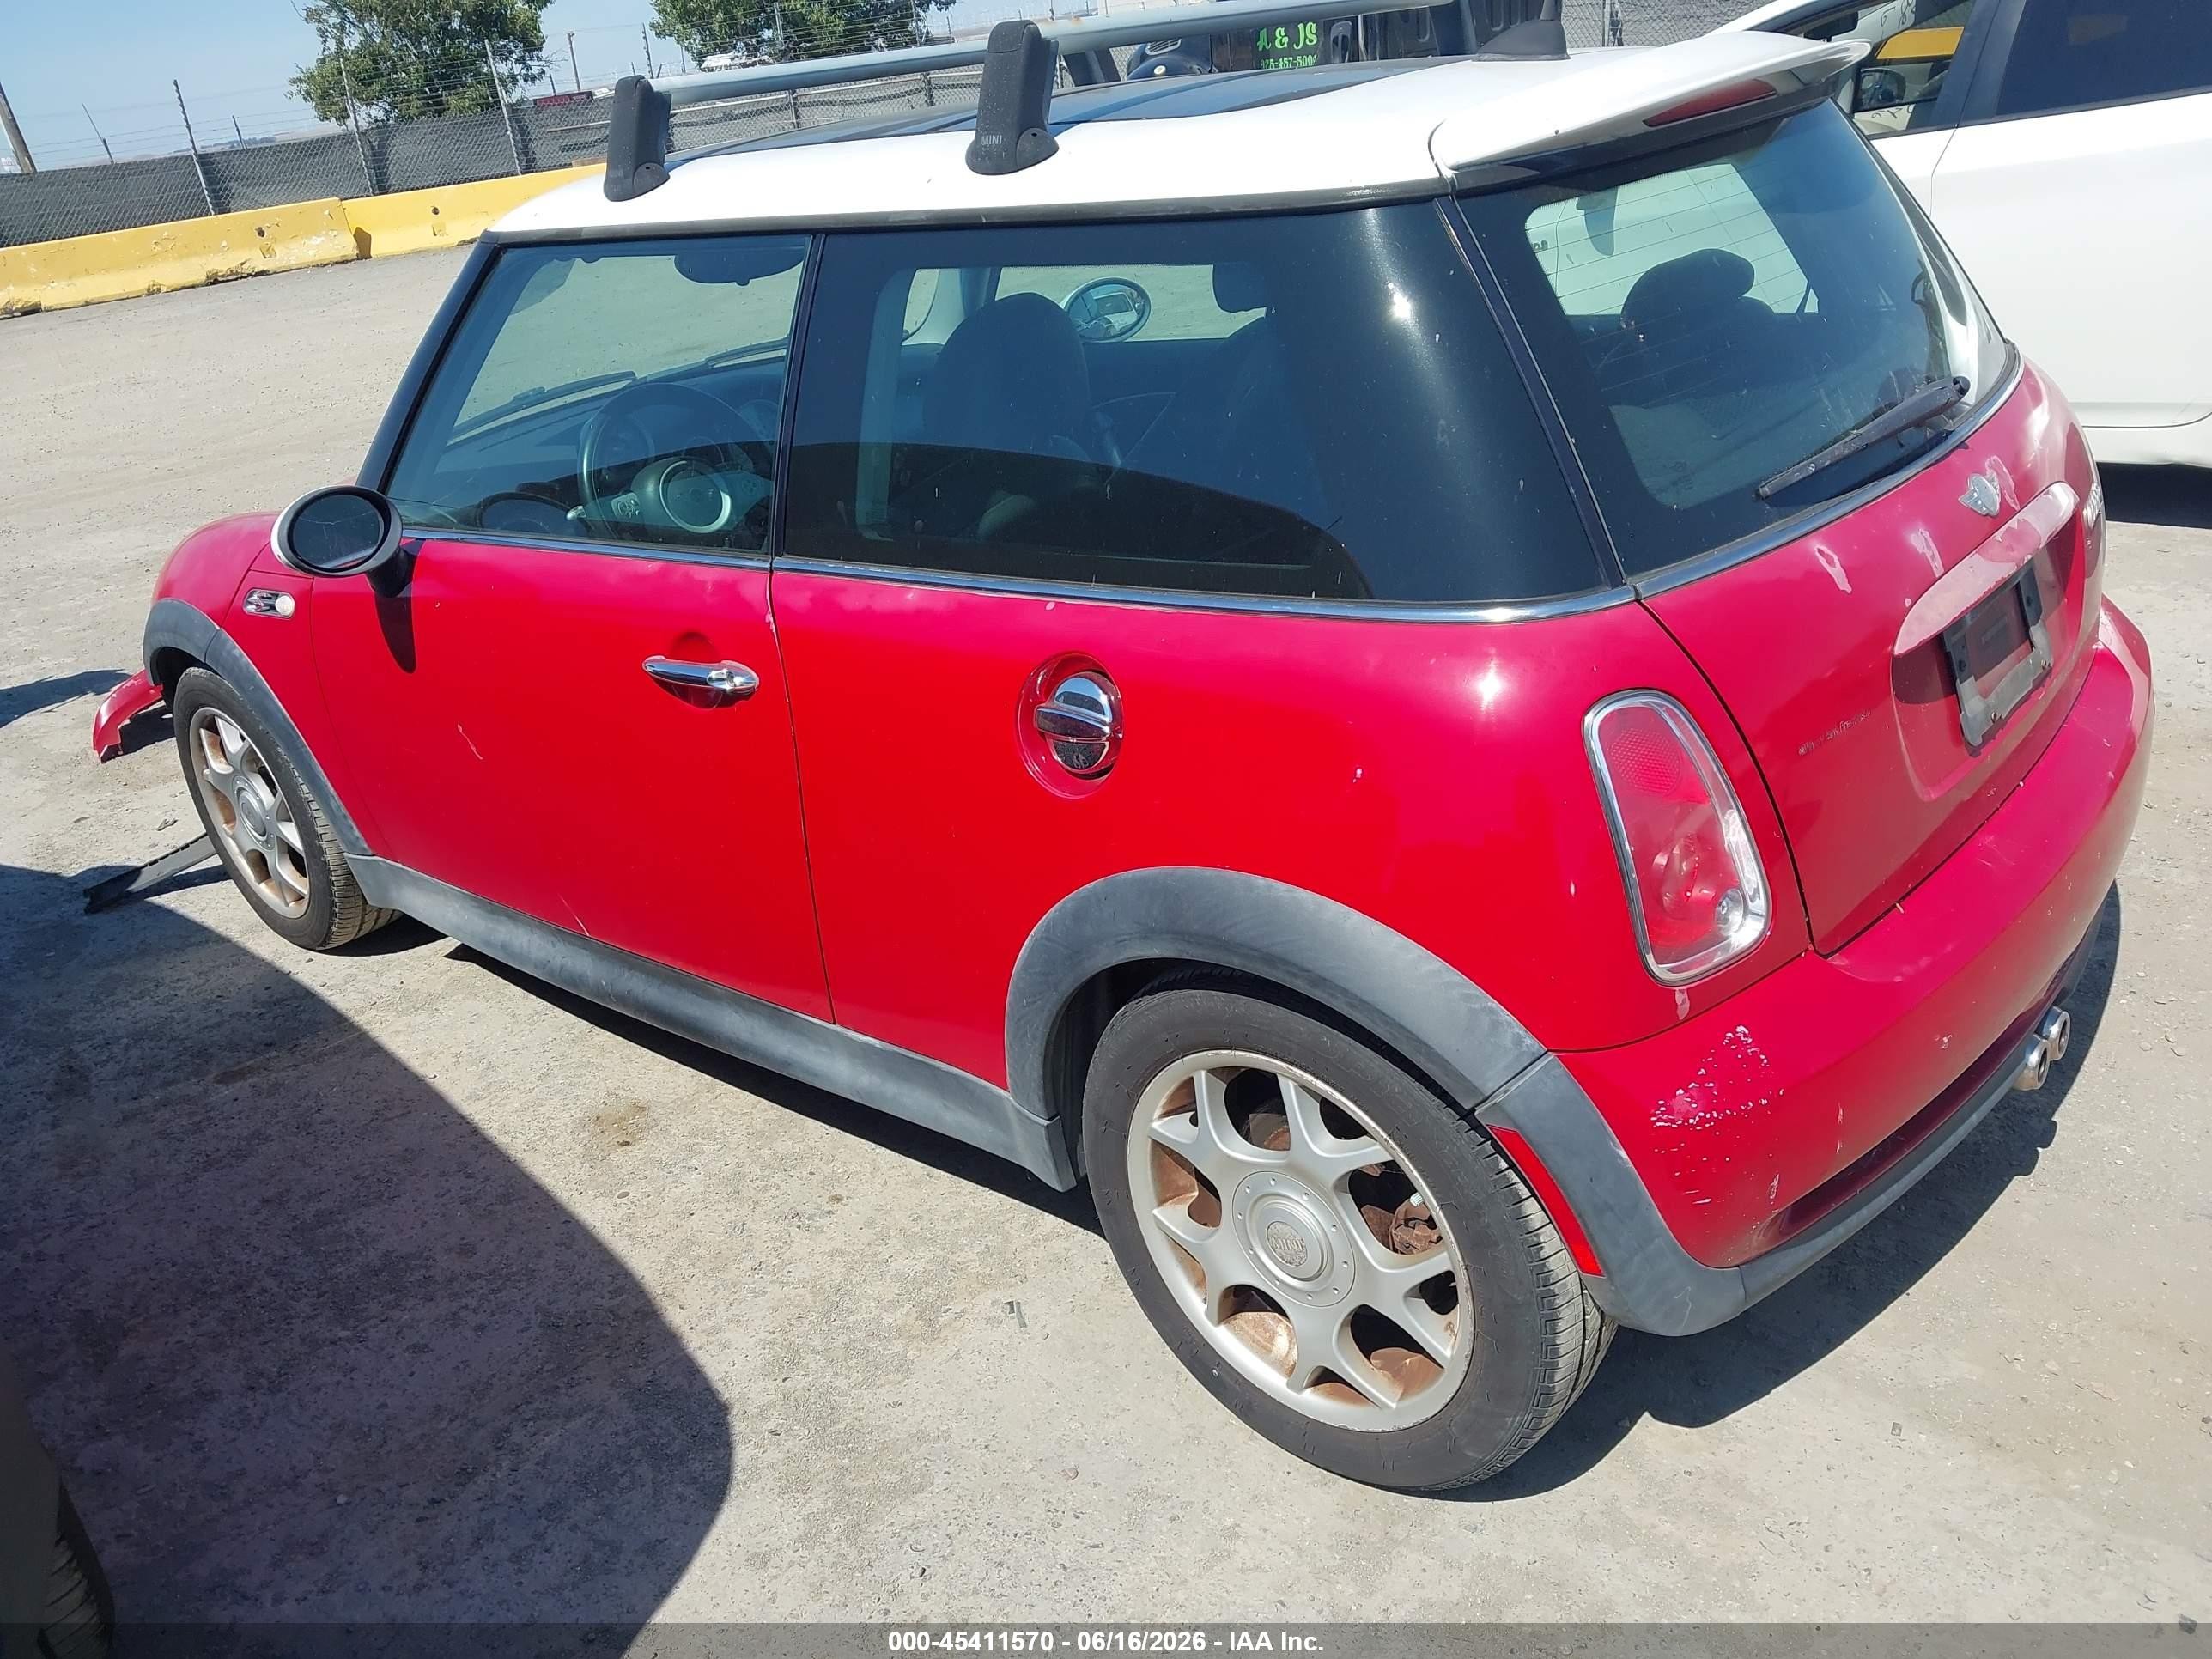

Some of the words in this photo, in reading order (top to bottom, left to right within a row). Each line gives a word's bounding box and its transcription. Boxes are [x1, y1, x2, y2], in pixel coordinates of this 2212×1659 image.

[1257, 27, 1271, 51] A
[1275, 27, 1288, 48] &
[981, 135, 1002, 145] MINI
[1271, 1237, 1305, 1251] MINI
